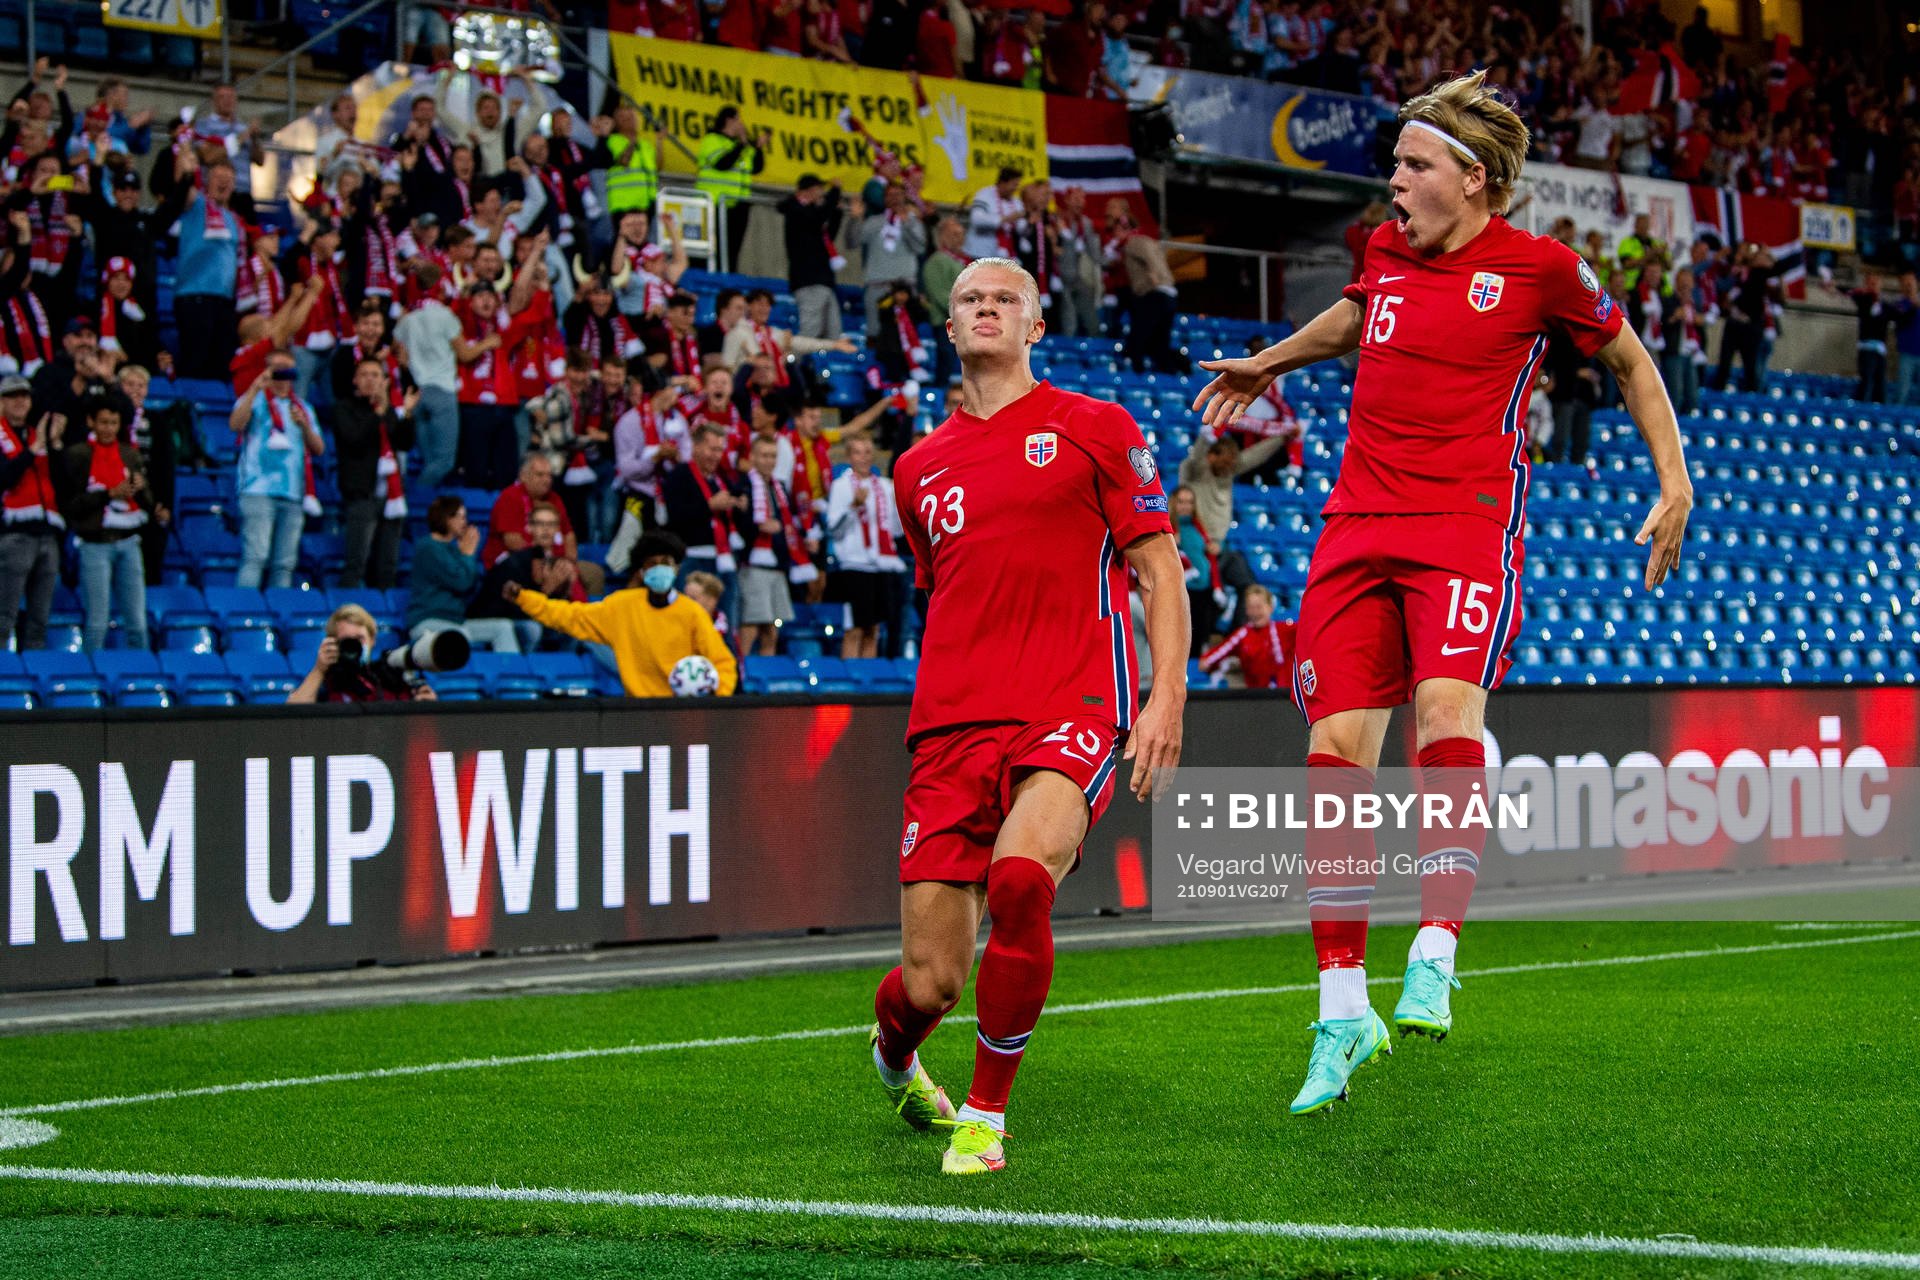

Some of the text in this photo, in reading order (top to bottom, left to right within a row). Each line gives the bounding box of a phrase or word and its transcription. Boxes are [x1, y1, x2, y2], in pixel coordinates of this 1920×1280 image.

[635, 54, 744, 104] HUMAN
[859, 95, 913, 127] FOR
[779, 127, 920, 167] WORKRS
[971, 121, 1036, 151] HUMAN
[1291, 100, 1357, 150] Bendit
[1571, 184, 1639, 214] NORE
[1366, 294, 1405, 344] 15
[920, 486, 965, 546] 23
[1446, 578, 1494, 634] 15
[245, 753, 395, 932] UP
[429, 743, 710, 918] WITH
